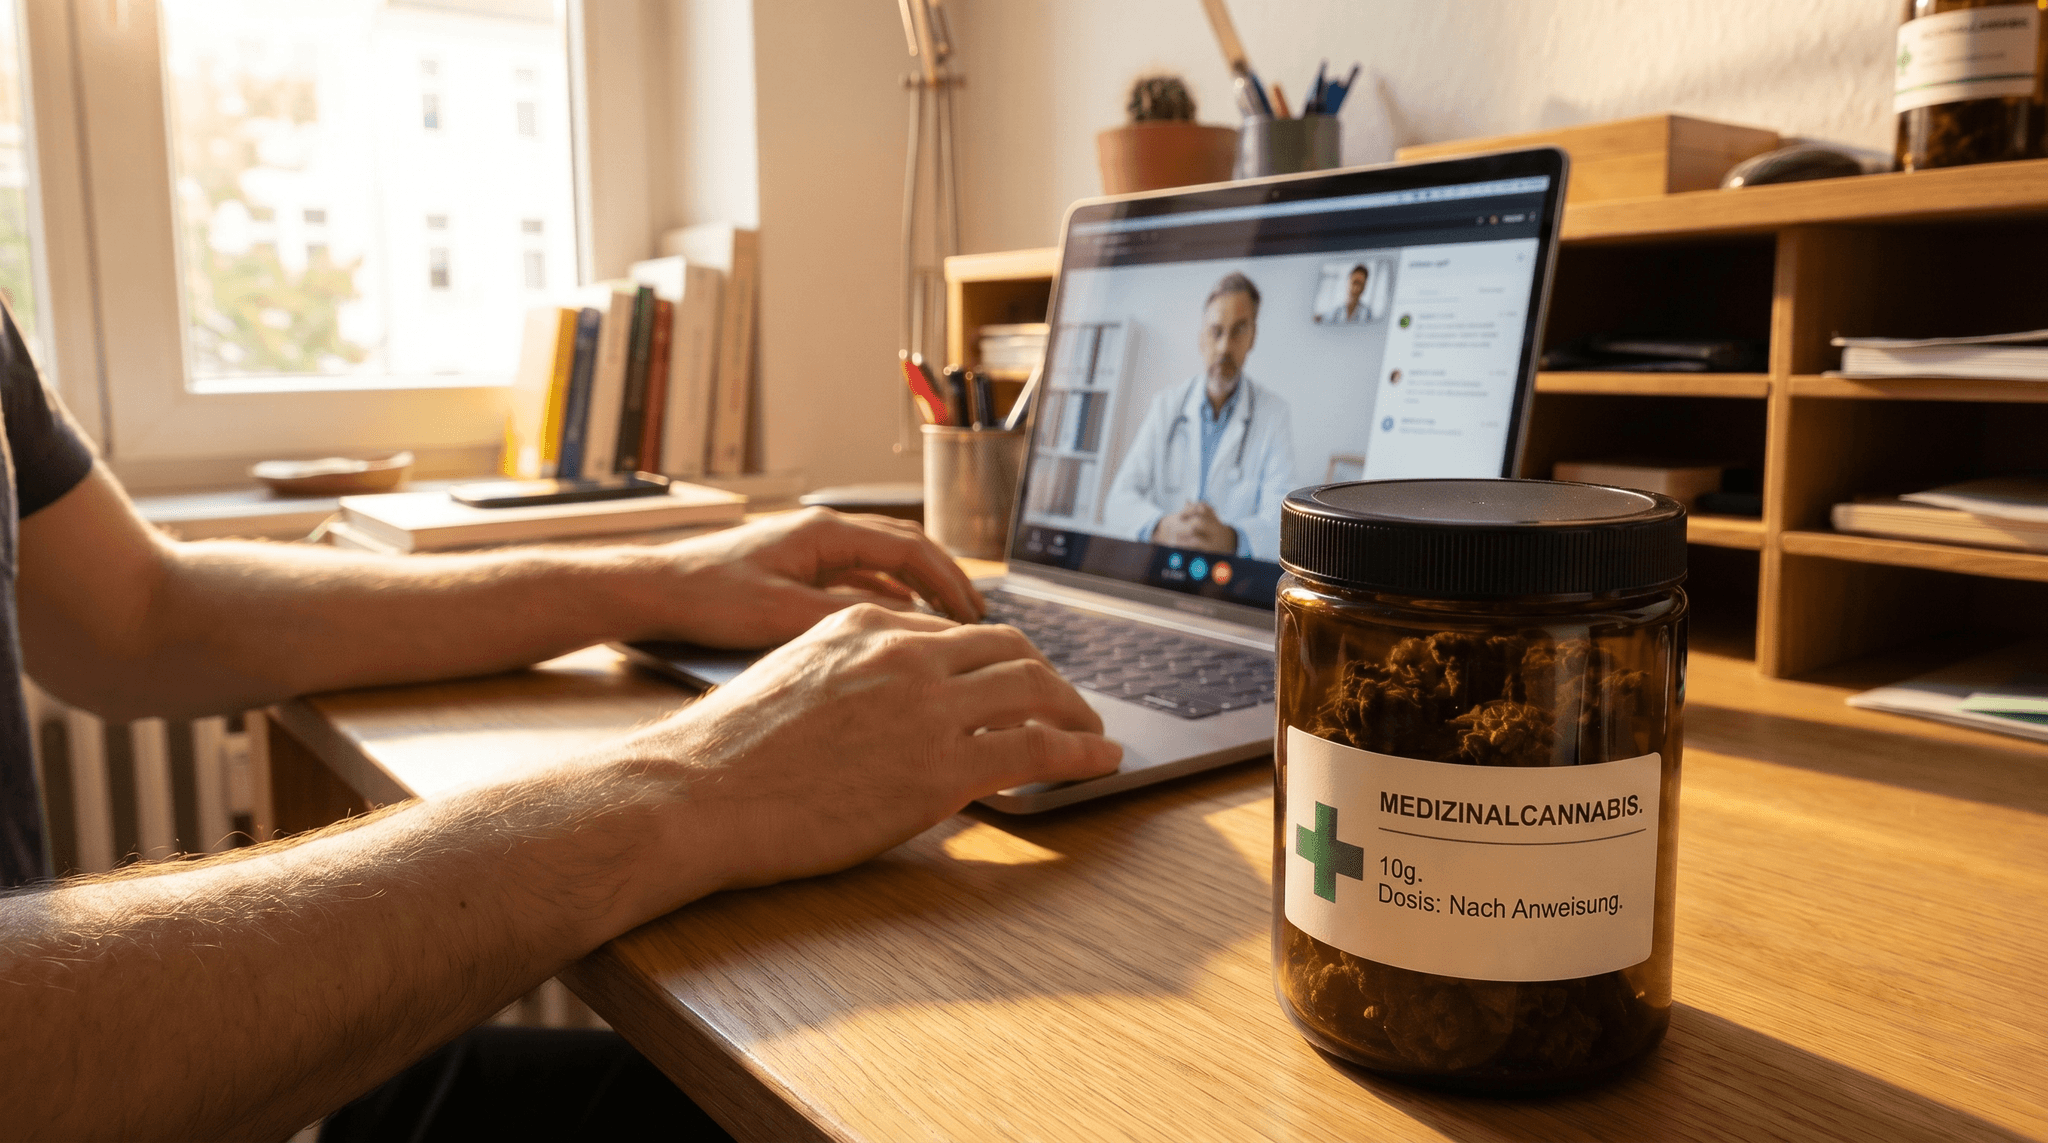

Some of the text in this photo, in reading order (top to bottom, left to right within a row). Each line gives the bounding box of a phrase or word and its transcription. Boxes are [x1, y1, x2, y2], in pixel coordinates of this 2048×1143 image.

[1379, 790, 1643, 827] MEDIZINALCANNABIS.
[1379, 855, 1423, 886] 10g.
[1378, 882, 1623, 920] Dosis: Nach Anweisung.
